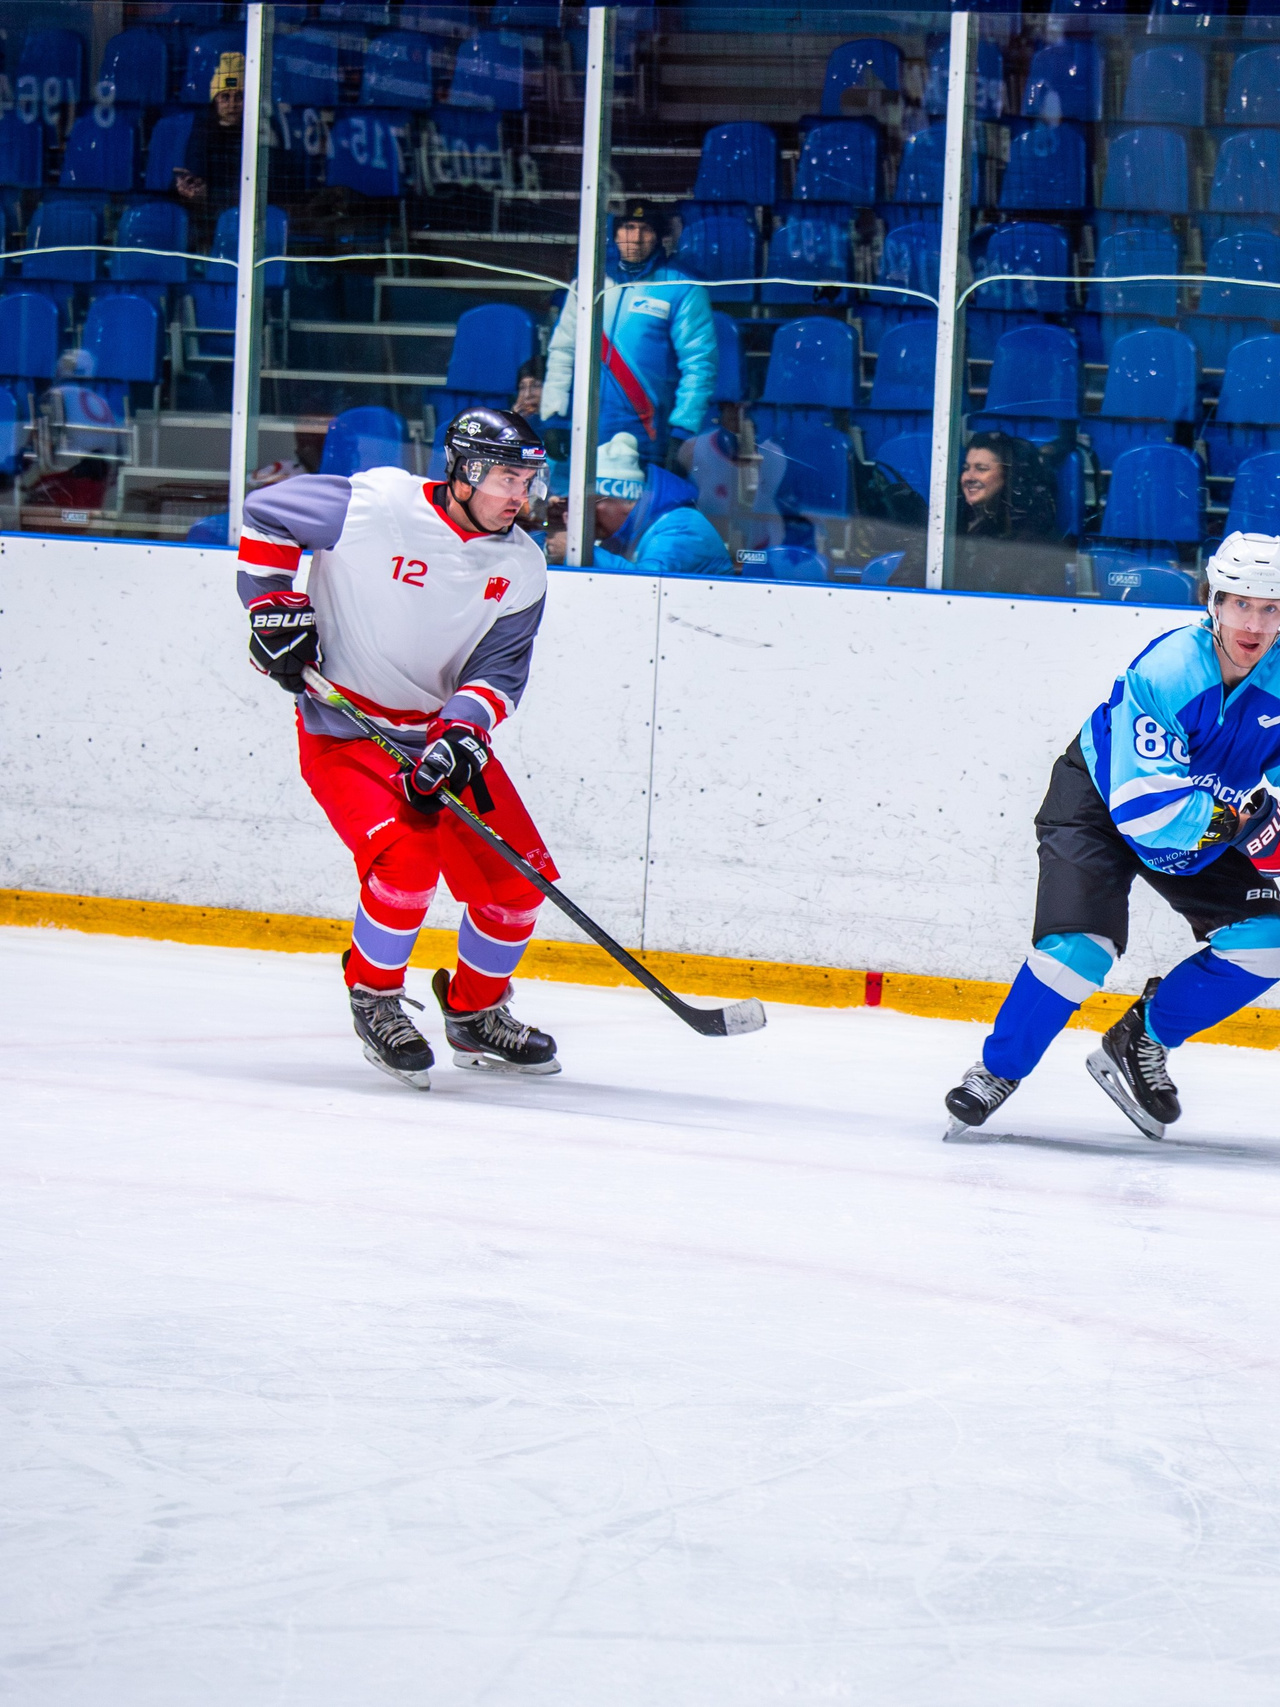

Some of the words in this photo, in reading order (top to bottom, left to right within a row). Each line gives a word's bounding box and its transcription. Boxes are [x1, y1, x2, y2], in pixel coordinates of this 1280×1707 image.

[596, 479, 643, 499] ССИ
[391, 555, 428, 588] 12
[371, 735, 410, 768] ALPH
[458, 736, 489, 770] BA
